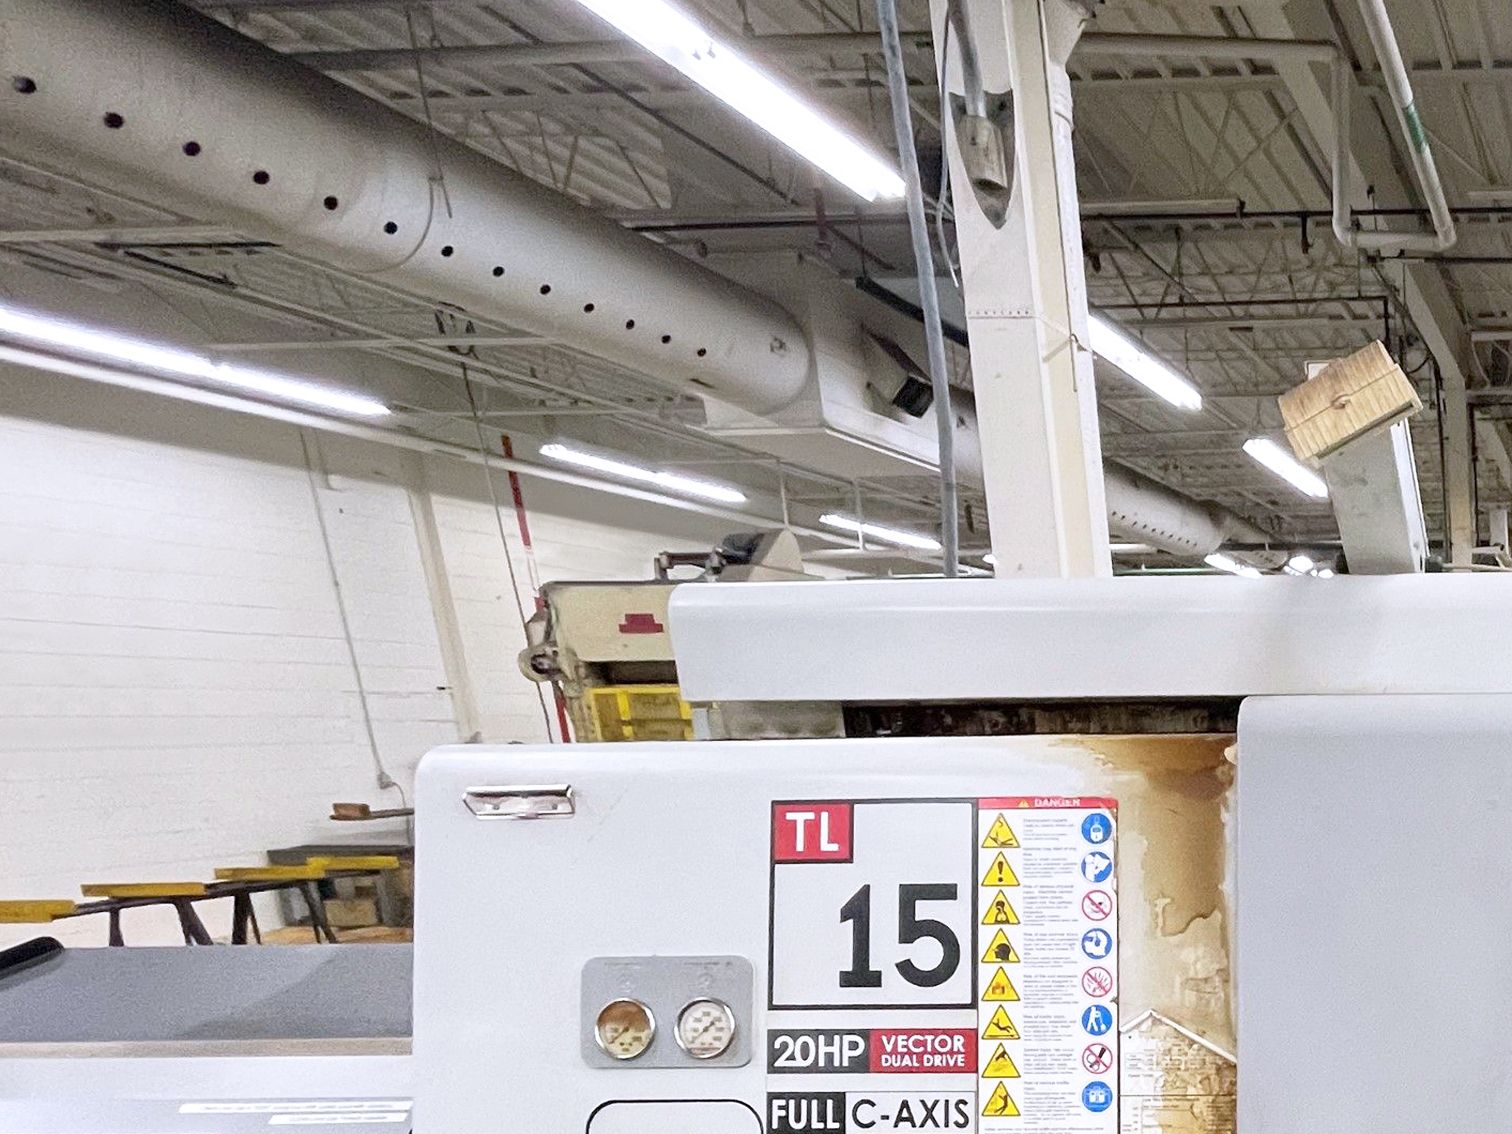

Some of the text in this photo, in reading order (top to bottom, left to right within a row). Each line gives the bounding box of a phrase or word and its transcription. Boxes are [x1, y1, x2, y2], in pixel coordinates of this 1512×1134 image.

[1034, 798, 1081, 807] DANGER
[785, 811, 839, 852] TL
[839, 883, 961, 988] 15
[773, 1034, 965, 1067] 20HP VECTOR
[881, 1054, 965, 1067] DUAL DRIVE
[771, 1098, 970, 1130] FULL C-AXIS
